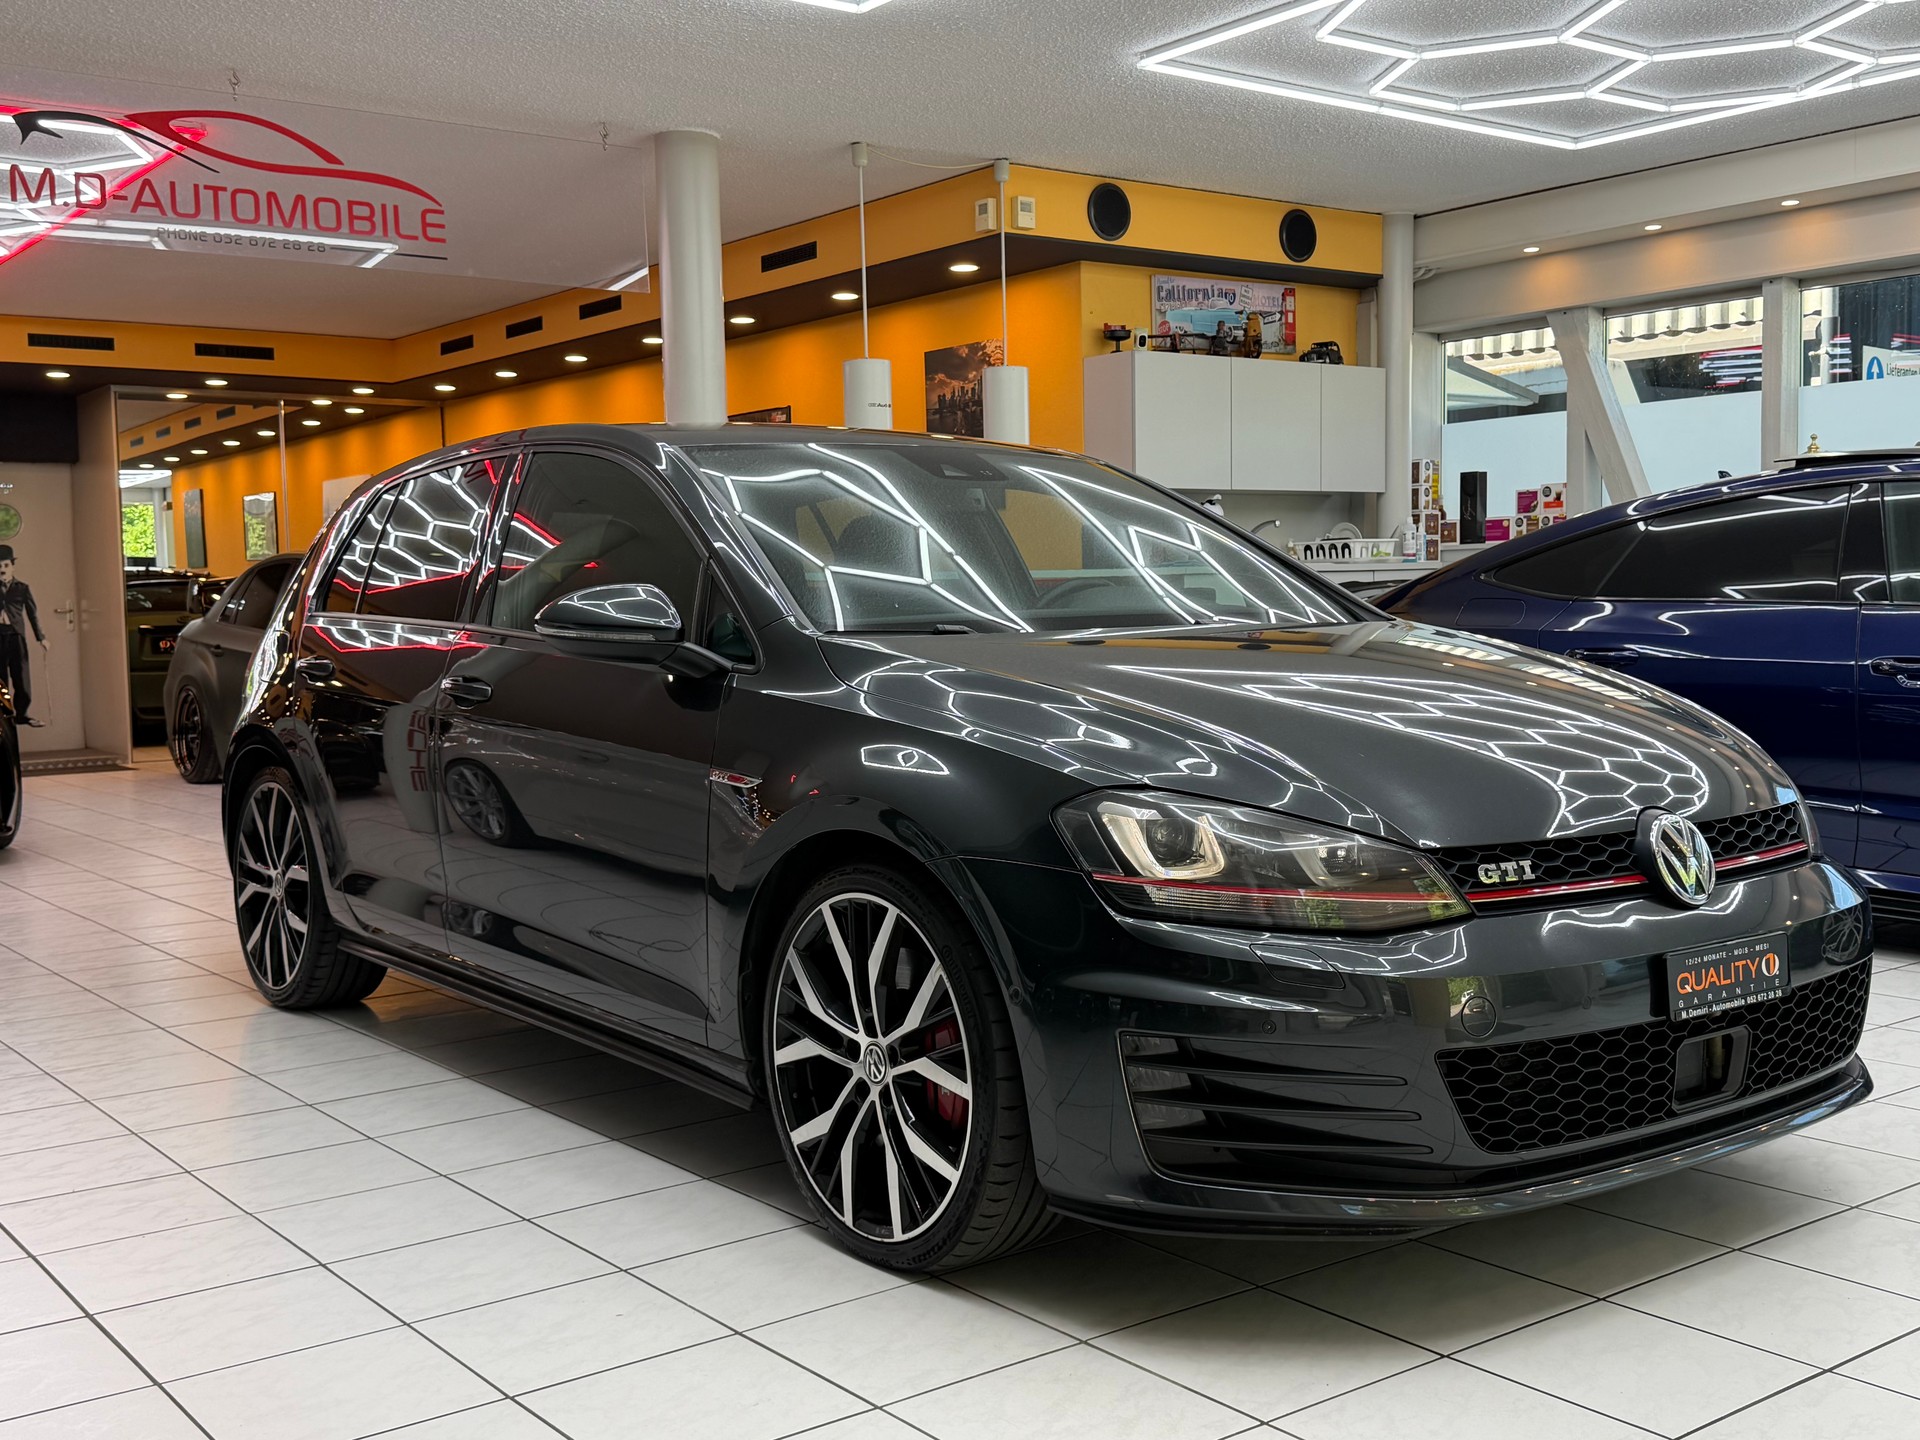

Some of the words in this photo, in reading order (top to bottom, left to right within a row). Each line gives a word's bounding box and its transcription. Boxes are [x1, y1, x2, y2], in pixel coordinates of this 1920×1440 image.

[9, 163, 448, 244] M.D-AUTOMOBILE
[156, 227, 208, 243] PHONE
[1156, 285, 1224, 303] California
[1477, 859, 1536, 884] GTI
[1703, 951, 1727, 962] MONATE
[1733, 946, 1749, 955] MOIS
[1755, 942, 1770, 951] MESI
[1676, 956, 1760, 995] QUALITY
[1678, 978, 1780, 1009] GARANTIE
[1746, 994, 1757, 1005] 052
